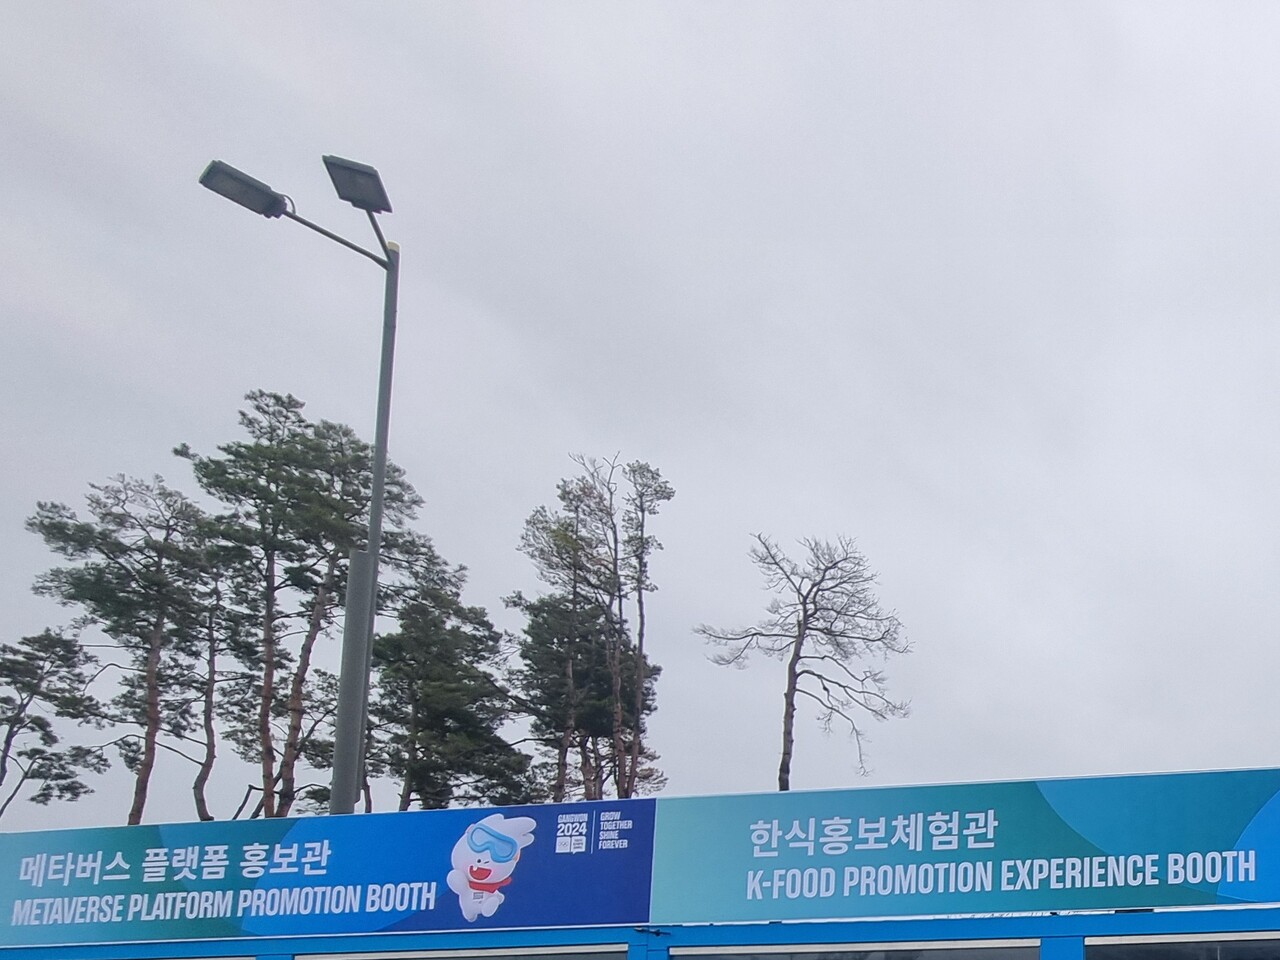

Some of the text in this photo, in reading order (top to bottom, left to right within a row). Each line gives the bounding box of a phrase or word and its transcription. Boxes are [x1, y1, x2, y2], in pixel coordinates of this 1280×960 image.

[556, 822, 587, 836] 2024
[598, 839, 628, 850] FOREVER
[600, 820, 633, 830] TOGETHER
[749, 809, 999, 859] 한식홍보체험관
[19, 839, 332, 887] 메타버스 플랫폼 홍보관
[746, 850, 1257, 901] K-FOOD PROMOTION EXPERIENCE BOOTH
[11, 882, 437, 926] METAVERSE PLATFORM PROMOTION BOOTH
